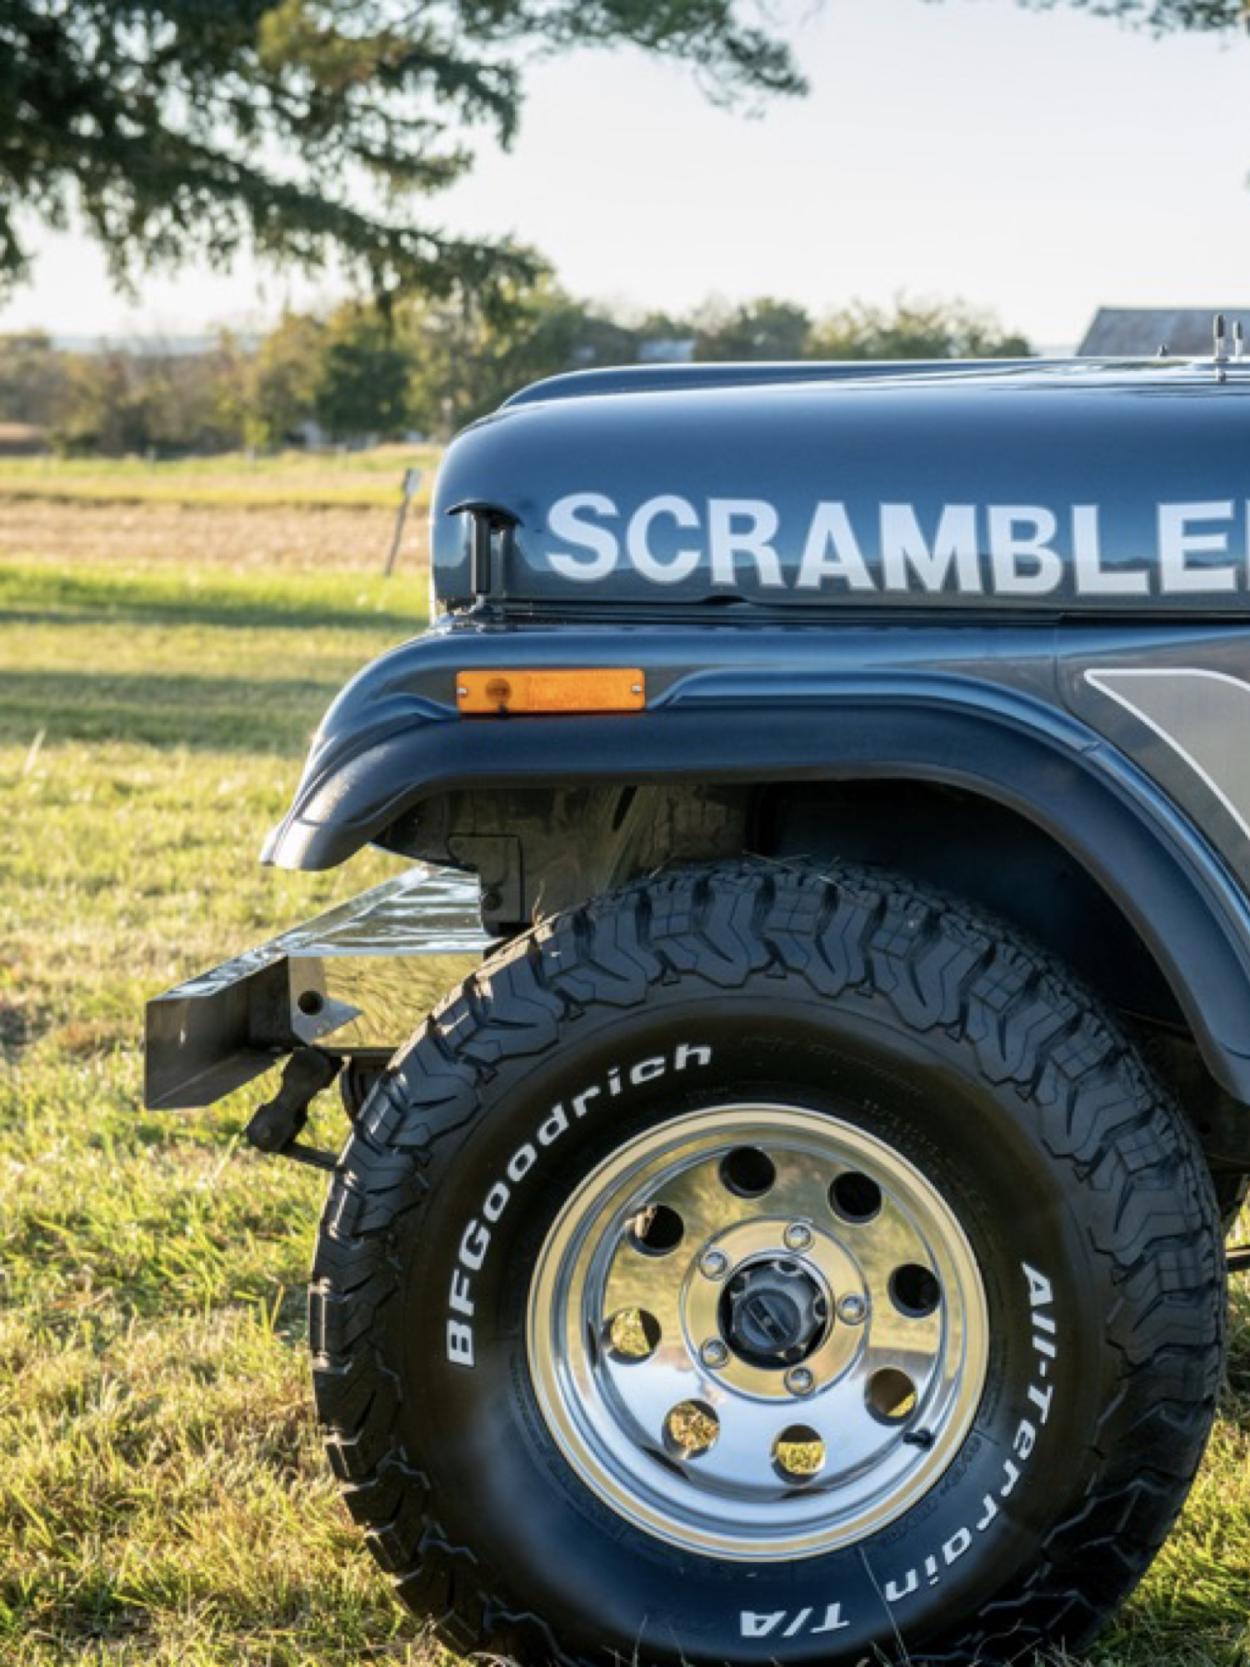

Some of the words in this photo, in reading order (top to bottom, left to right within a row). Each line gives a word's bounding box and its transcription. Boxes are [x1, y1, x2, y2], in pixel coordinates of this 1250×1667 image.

[446, 1043, 712, 1367] BFGoodrich
[885, 1261, 1057, 1603] All-Terrain
[739, 1602, 850, 1638] T/A
